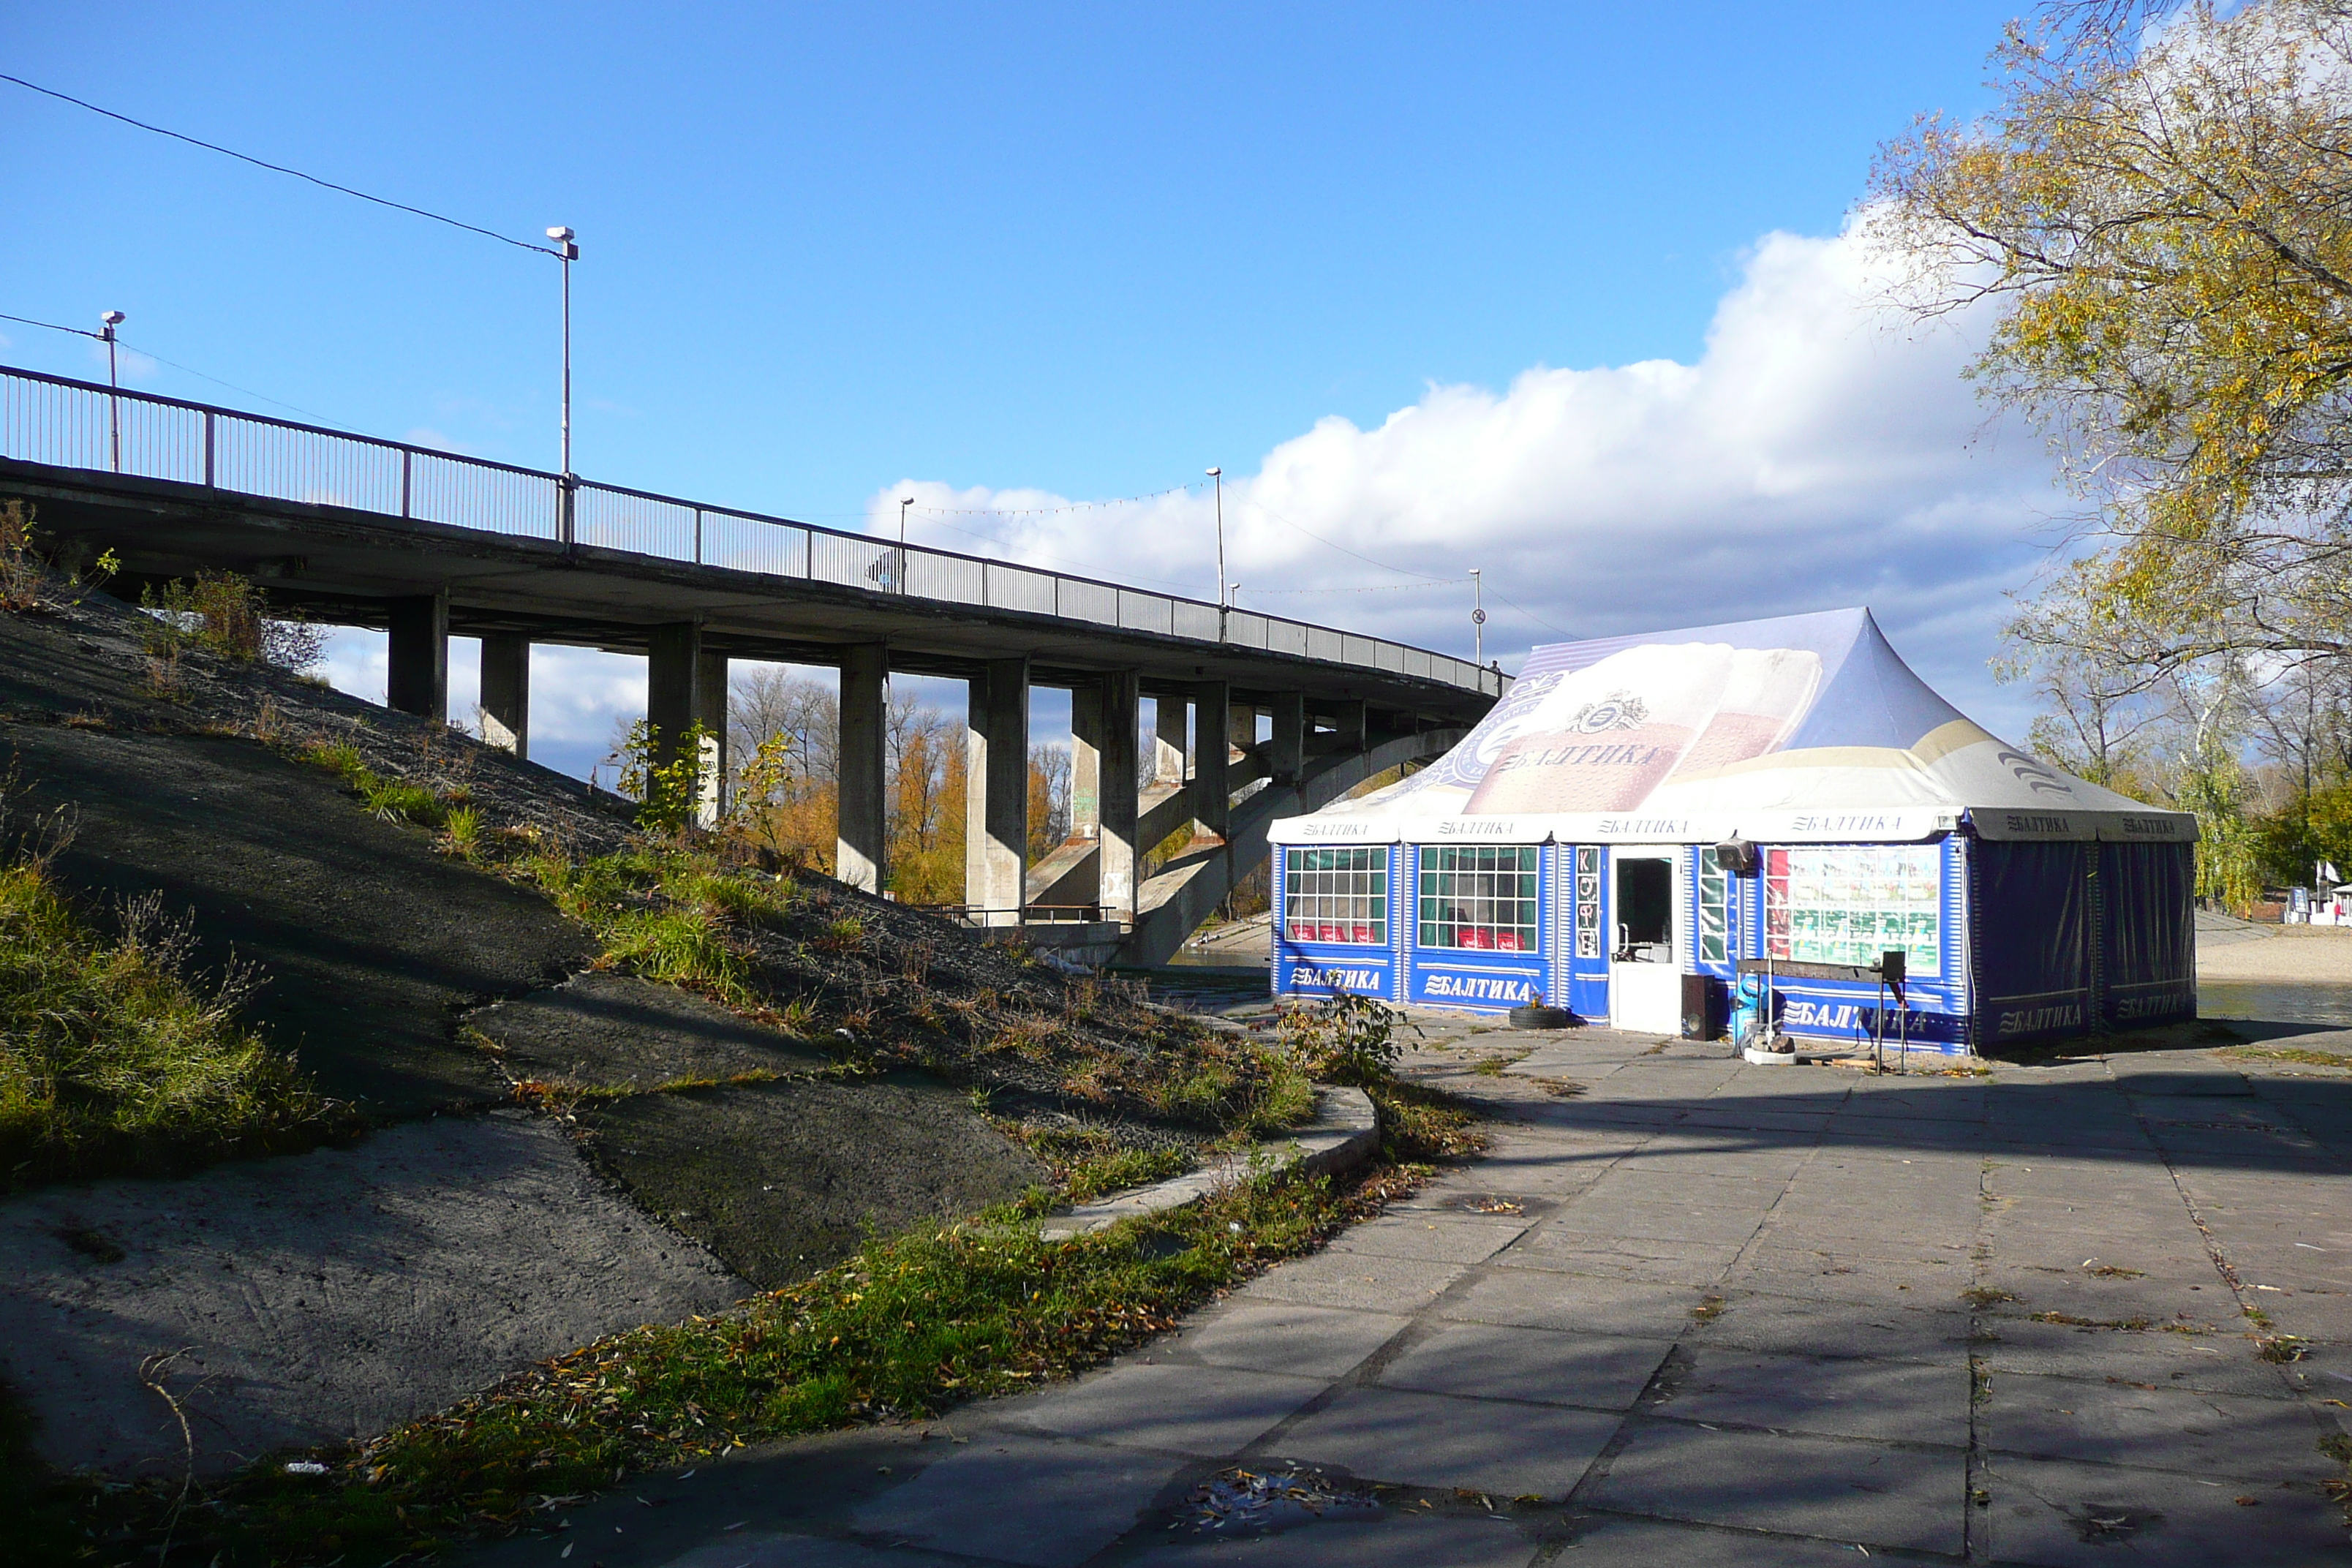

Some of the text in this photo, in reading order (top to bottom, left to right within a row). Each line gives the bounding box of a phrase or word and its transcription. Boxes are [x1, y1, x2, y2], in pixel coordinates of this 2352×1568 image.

[1509, 745, 1659, 770] БАЛТИКА
[1310, 823, 1368, 837] БАЛТИКА
[1447, 821, 1514, 834] БАЛТИКА
[1610, 820, 1688, 834] БАЛТИКА
[1806, 815, 1901, 830] БАЛТИКА
[2016, 816, 2070, 833] БАЛТИКА
[2130, 818, 2176, 834] БАЛТИКА
[1303, 968, 1380, 990] БАЛТИКА
[1439, 976, 1531, 1002] БАЛТИКА
[2127, 993, 2187, 1018] БАЛТИКА
[1797, 1002, 1926, 1031] БАЛТИКА
[2013, 1004, 2082, 1032] БАЛТИКА
